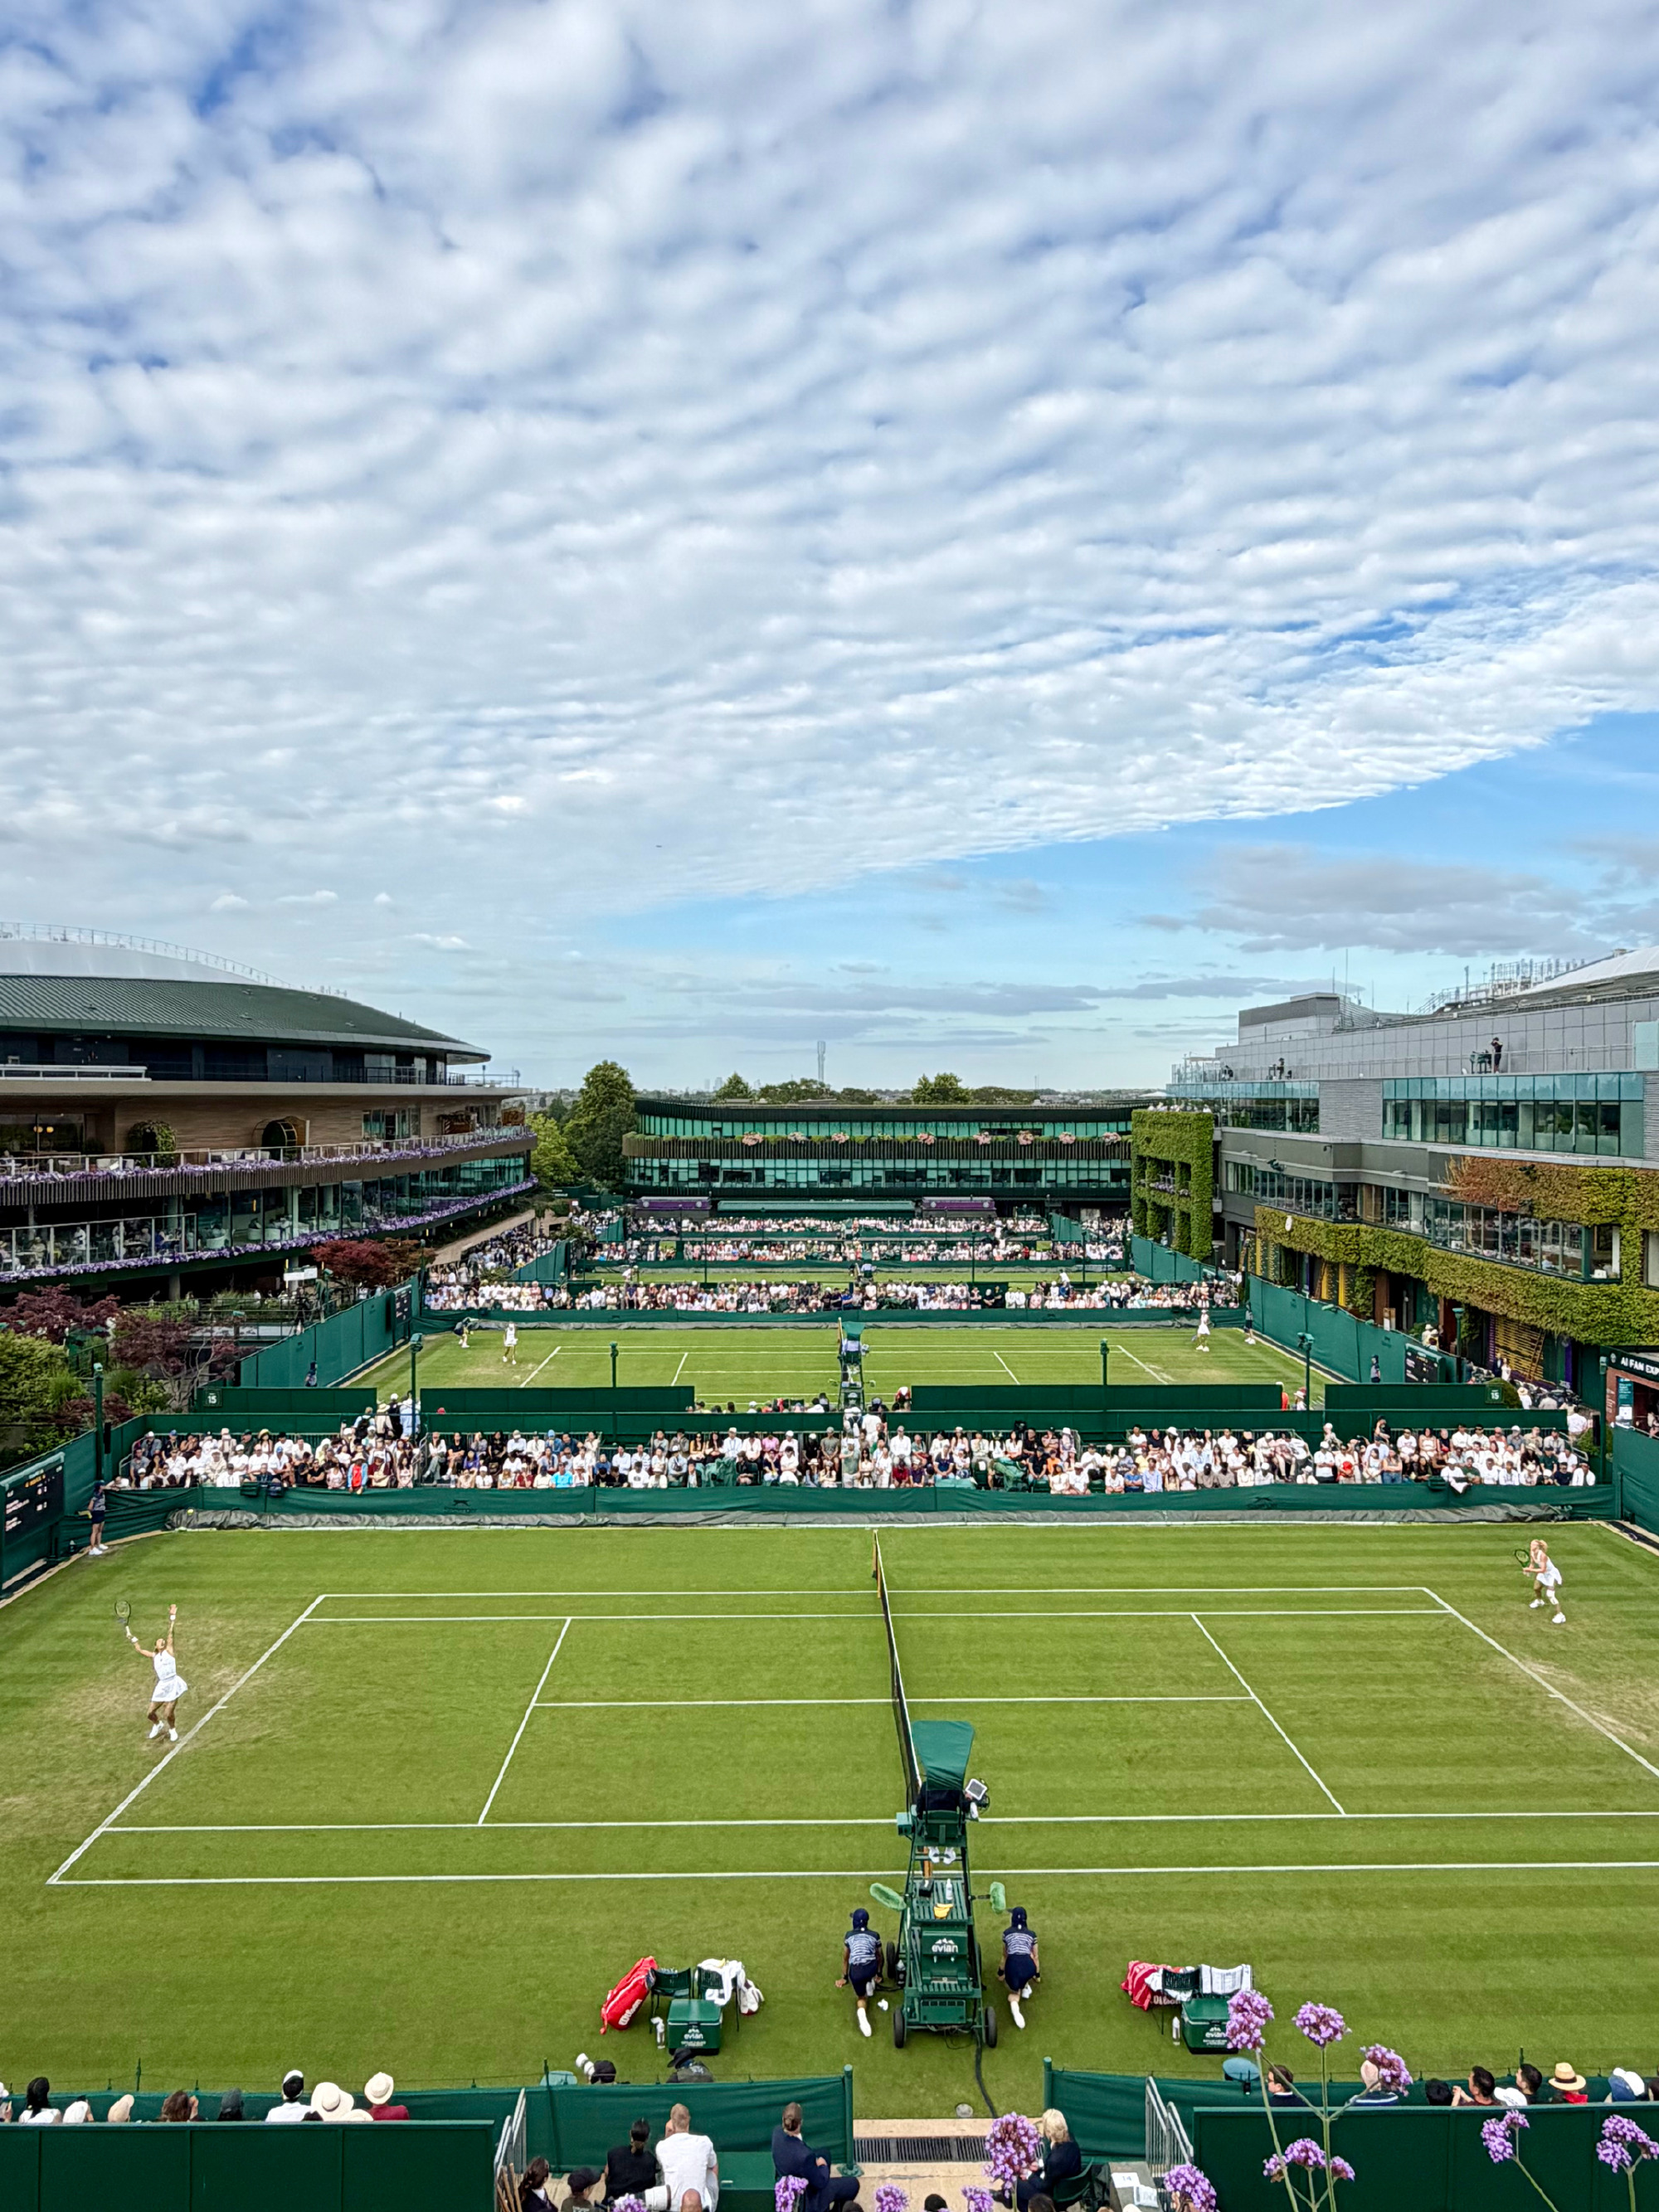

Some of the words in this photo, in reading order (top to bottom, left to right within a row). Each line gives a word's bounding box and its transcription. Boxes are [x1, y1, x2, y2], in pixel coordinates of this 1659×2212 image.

[1621, 1357, 1628, 1367] AI
[1629, 1359, 1644, 1372] FAN
[207, 1395, 216, 1404] 15
[932, 1944, 959, 1953] evian
[618, 1999, 643, 2025] Wilson
